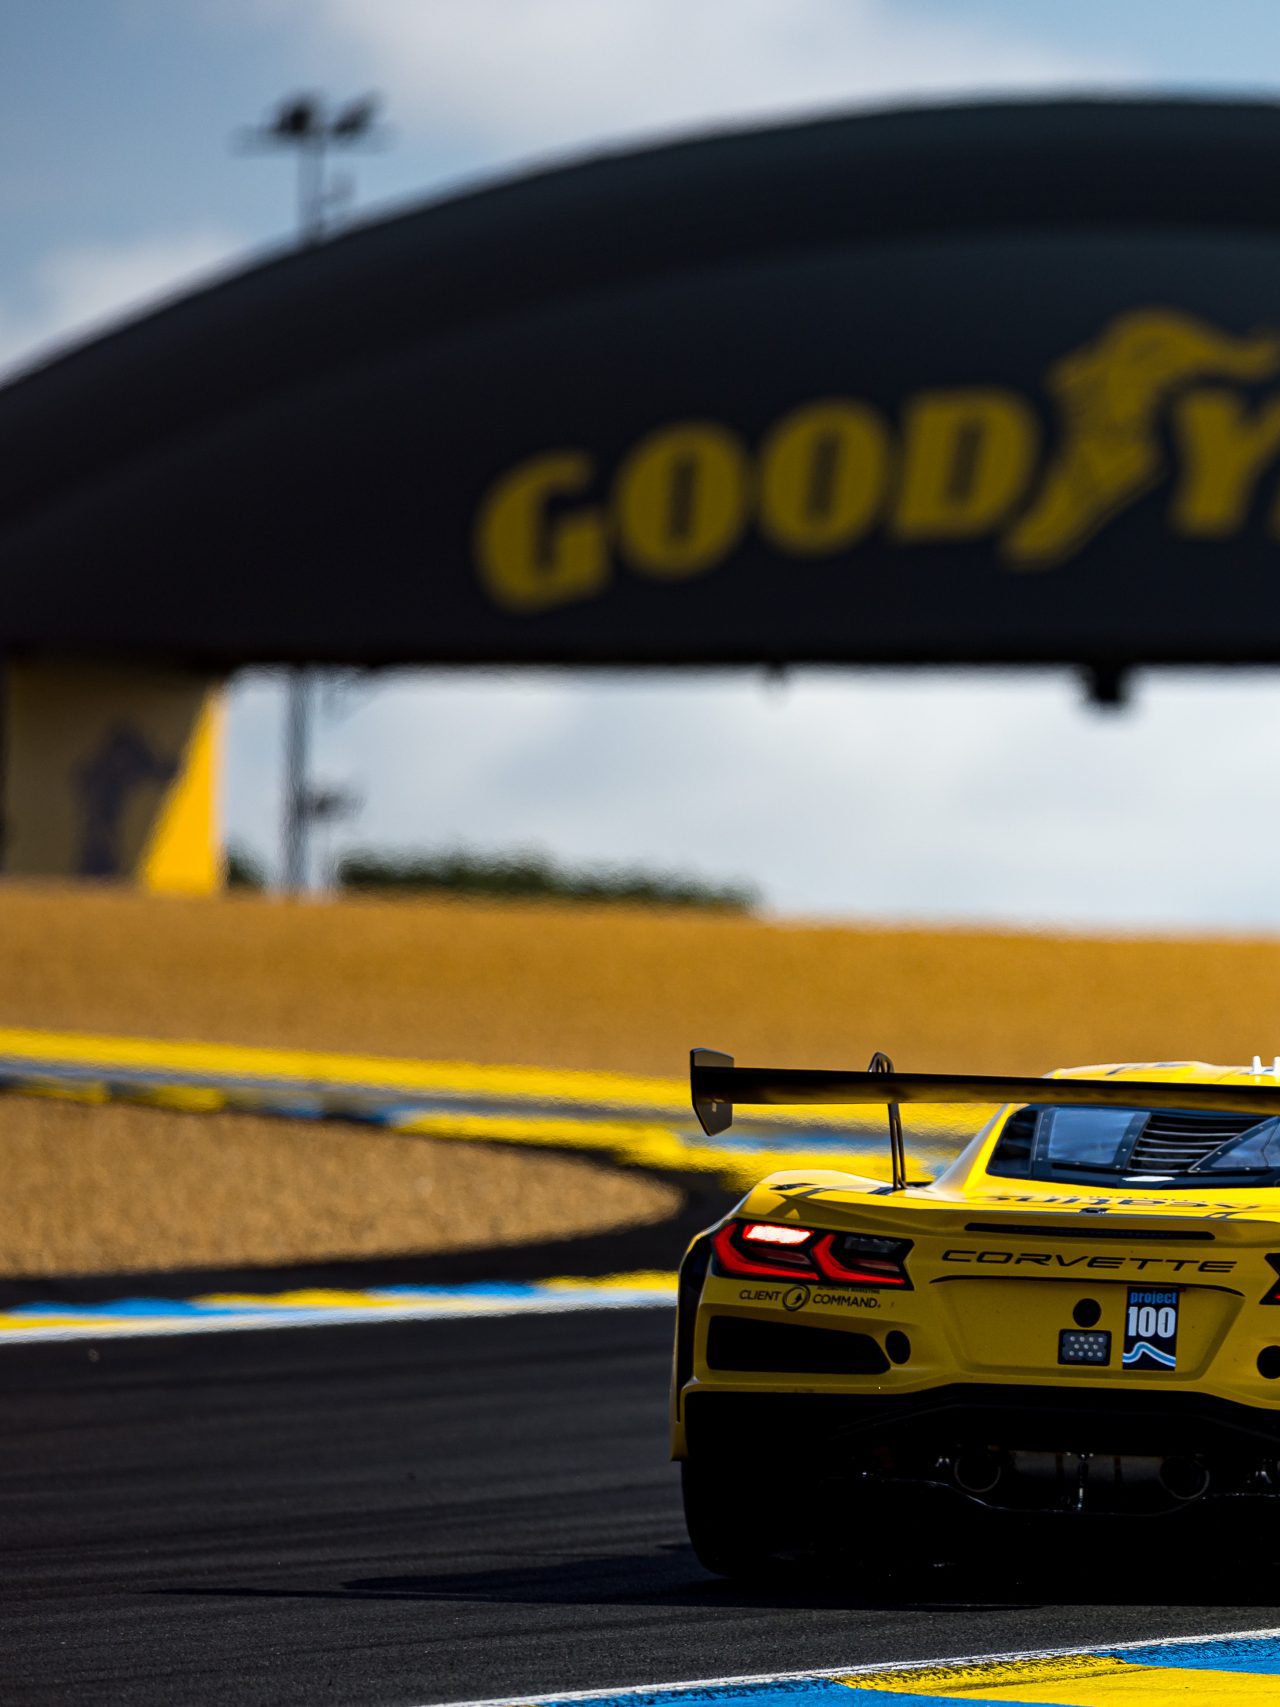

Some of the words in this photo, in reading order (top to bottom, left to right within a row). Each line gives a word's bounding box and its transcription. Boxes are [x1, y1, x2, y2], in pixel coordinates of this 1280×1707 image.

[941, 1249, 1238, 1273] CORVETTE
[739, 1289, 782, 1302] CLIENT
[1129, 1291, 1178, 1305] project
[1127, 1306, 1177, 1338] 100
